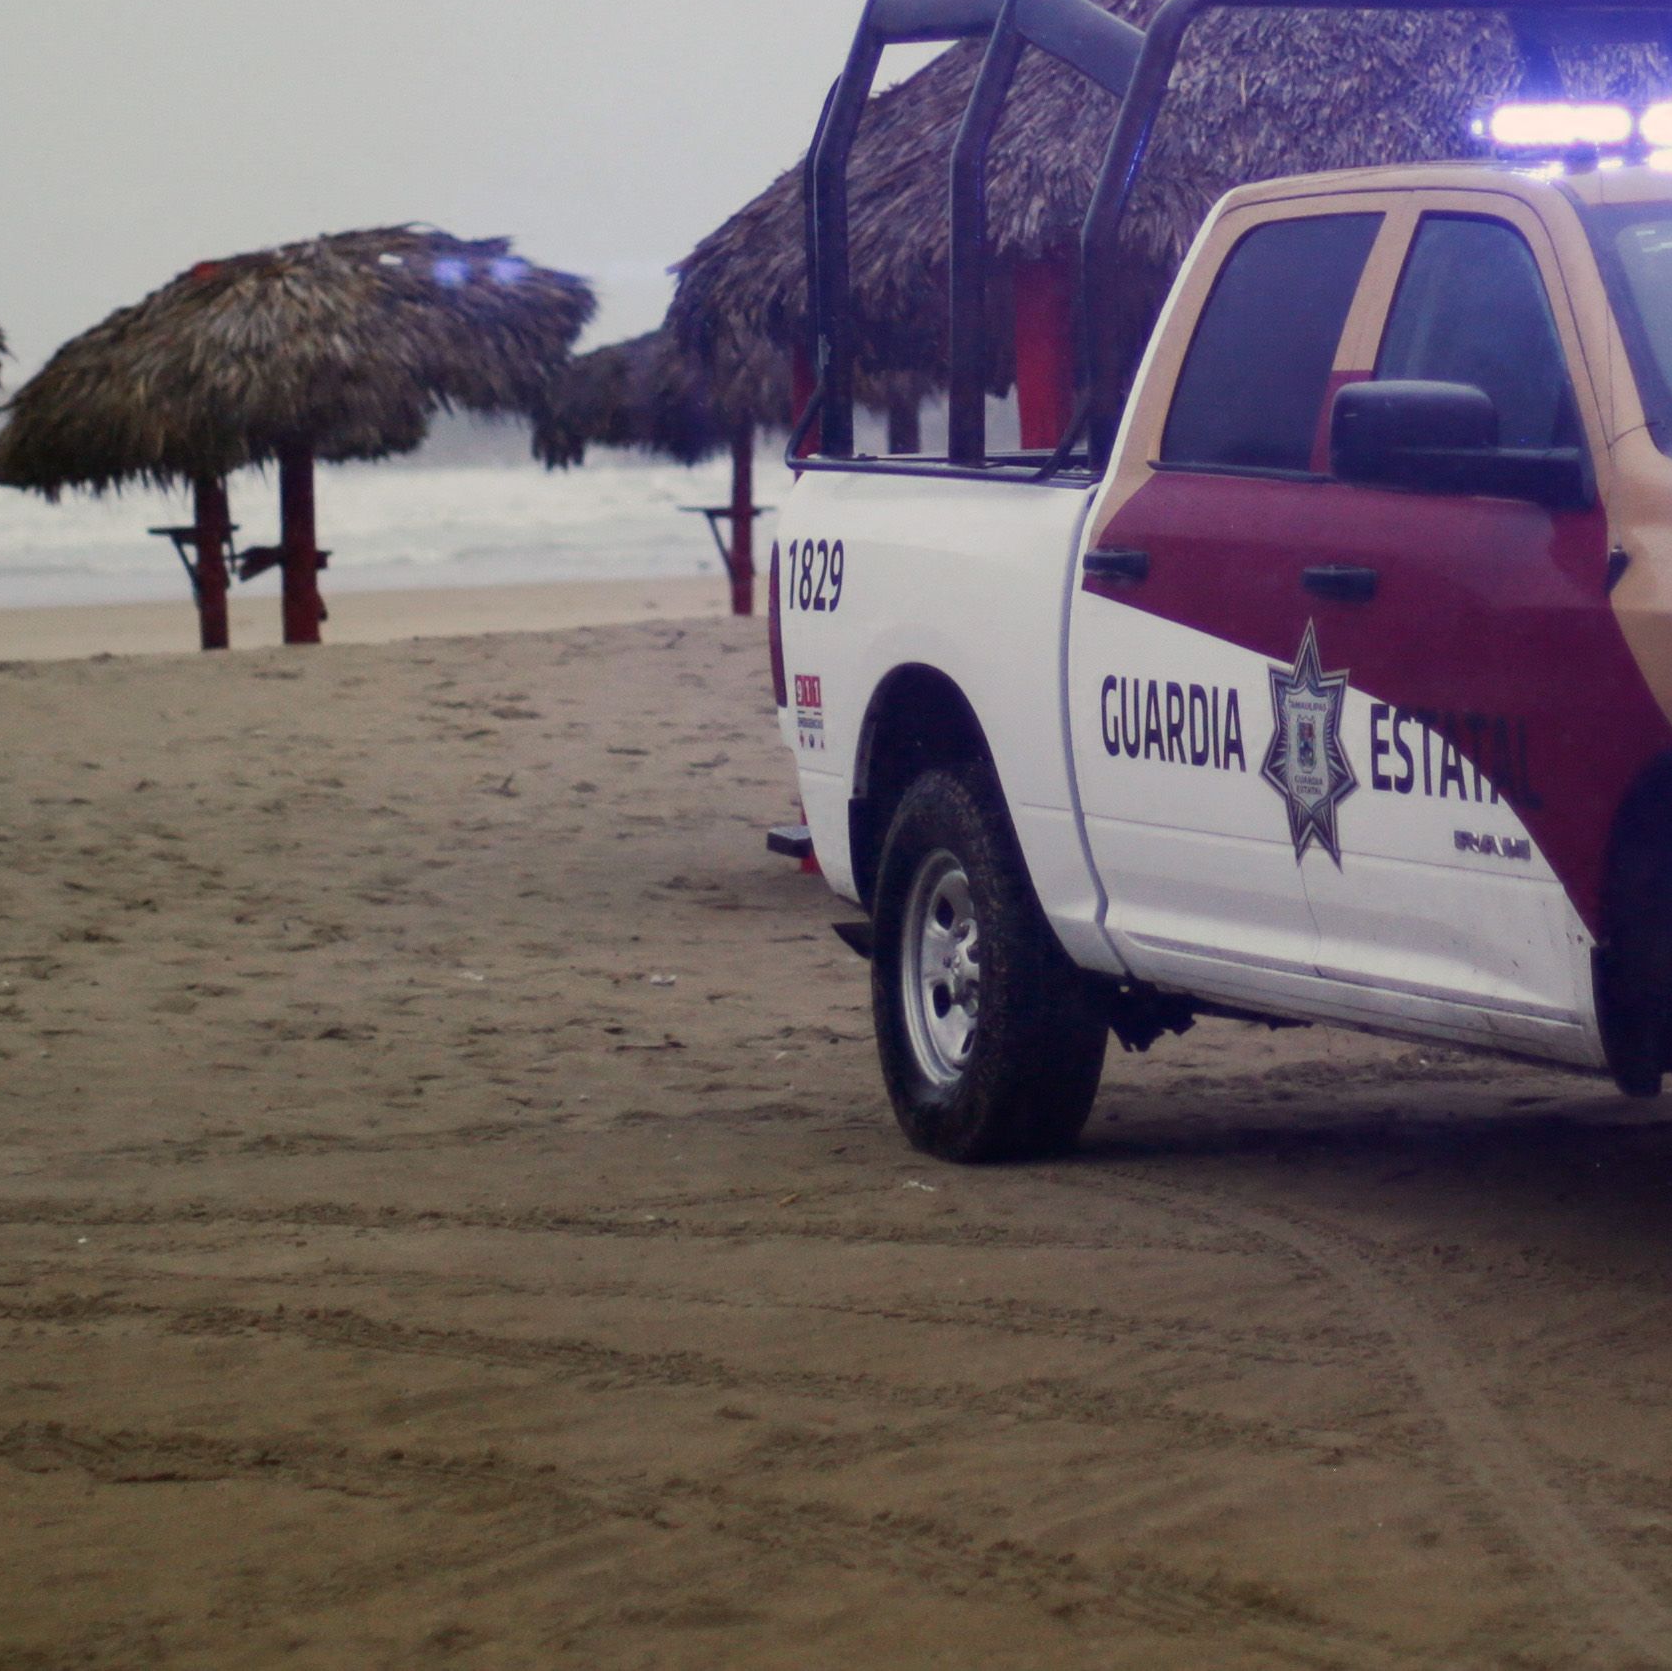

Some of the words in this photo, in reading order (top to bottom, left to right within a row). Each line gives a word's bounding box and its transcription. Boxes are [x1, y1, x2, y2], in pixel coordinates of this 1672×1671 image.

[789, 538, 844, 612] 1829
[796, 679, 819, 704] 911
[1100, 674, 1247, 774] GUARDIA
[1370, 702, 1544, 812] ESTATAL
[1453, 830, 1532, 862] RAM
